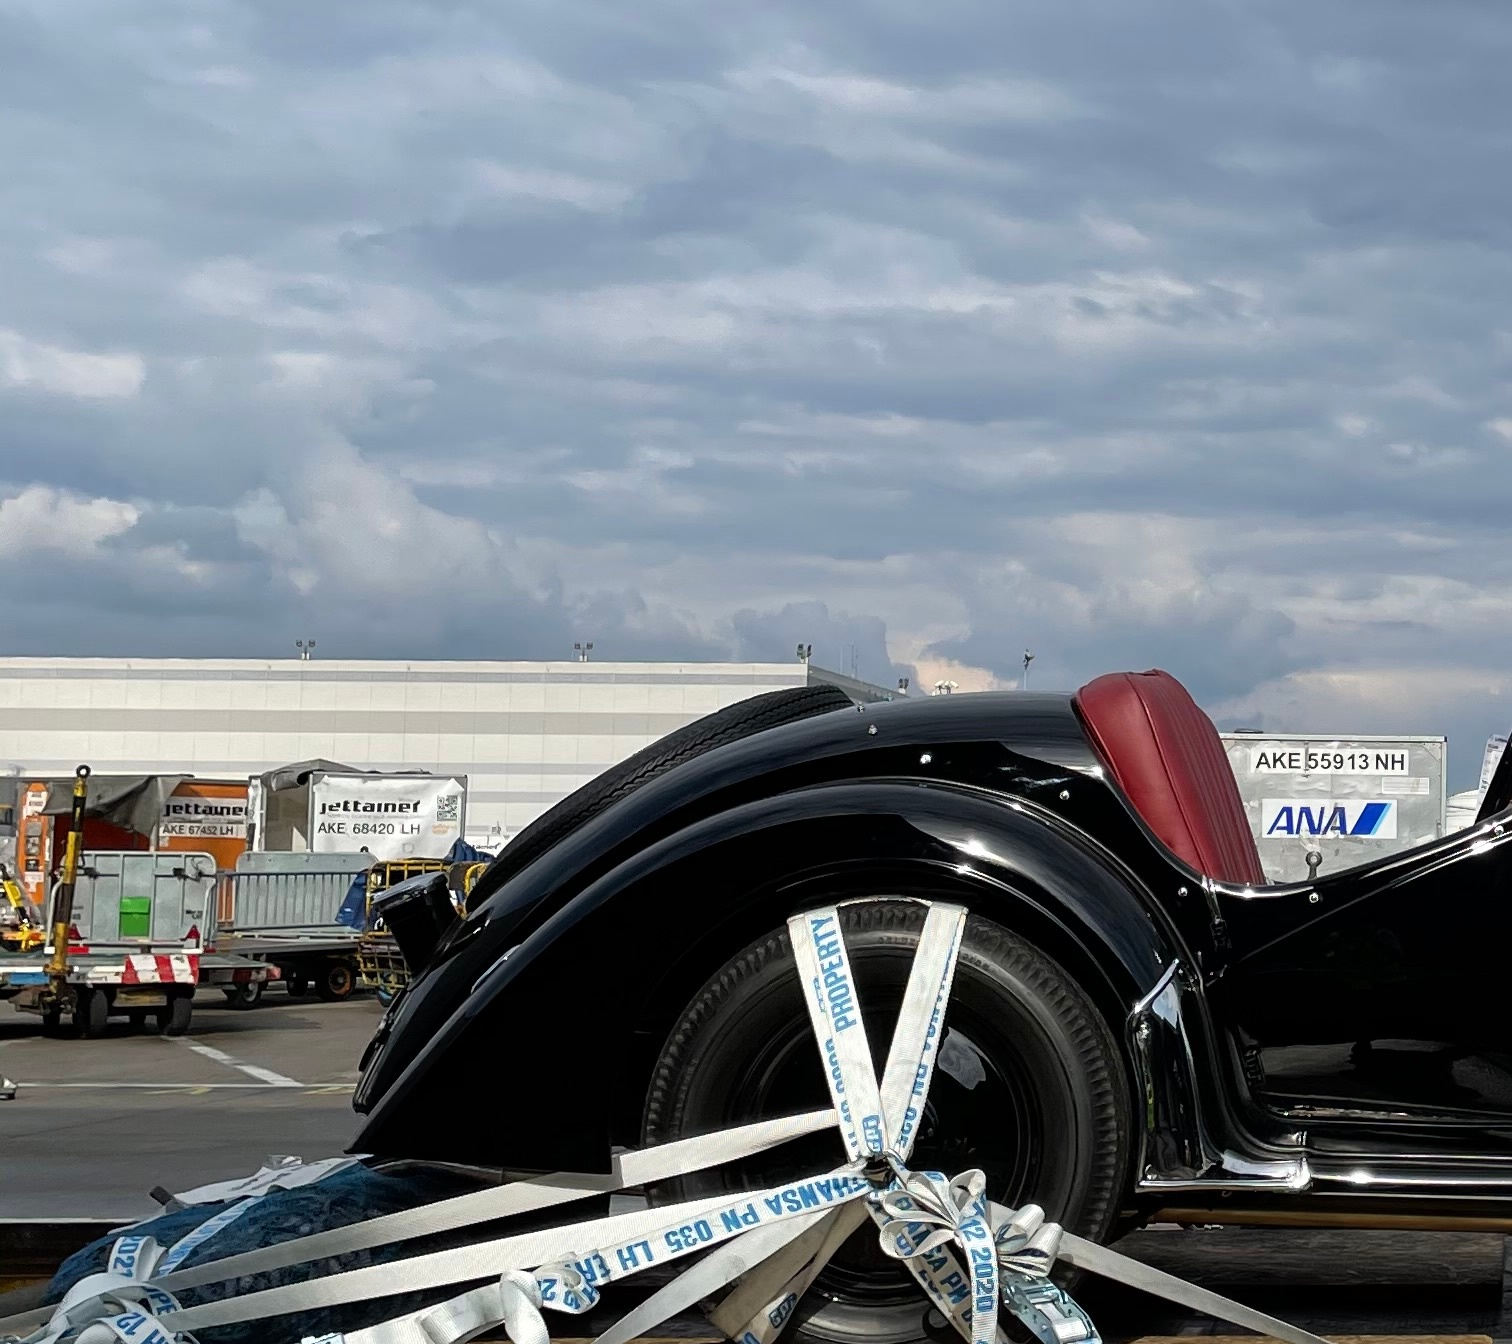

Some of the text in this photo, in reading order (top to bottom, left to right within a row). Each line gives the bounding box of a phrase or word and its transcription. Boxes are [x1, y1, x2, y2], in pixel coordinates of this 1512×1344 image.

[1255, 752, 1405, 771] AKE 55913 NH
[319, 799, 421, 815] jettainer
[1267, 806, 1348, 835] ANA
[162, 824, 185, 835] AKE
[220, 825, 234, 836] LH
[317, 822, 346, 834] AKE
[352, 822, 395, 835] 68420
[401, 823, 421, 835] LH
[810, 916, 857, 1033] PROPERTY
[720, 1203, 761, 1233] PN
[664, 1220, 713, 1254] 035
[617, 1240, 655, 1271] LH
[970, 1247, 997, 1313] 2020
